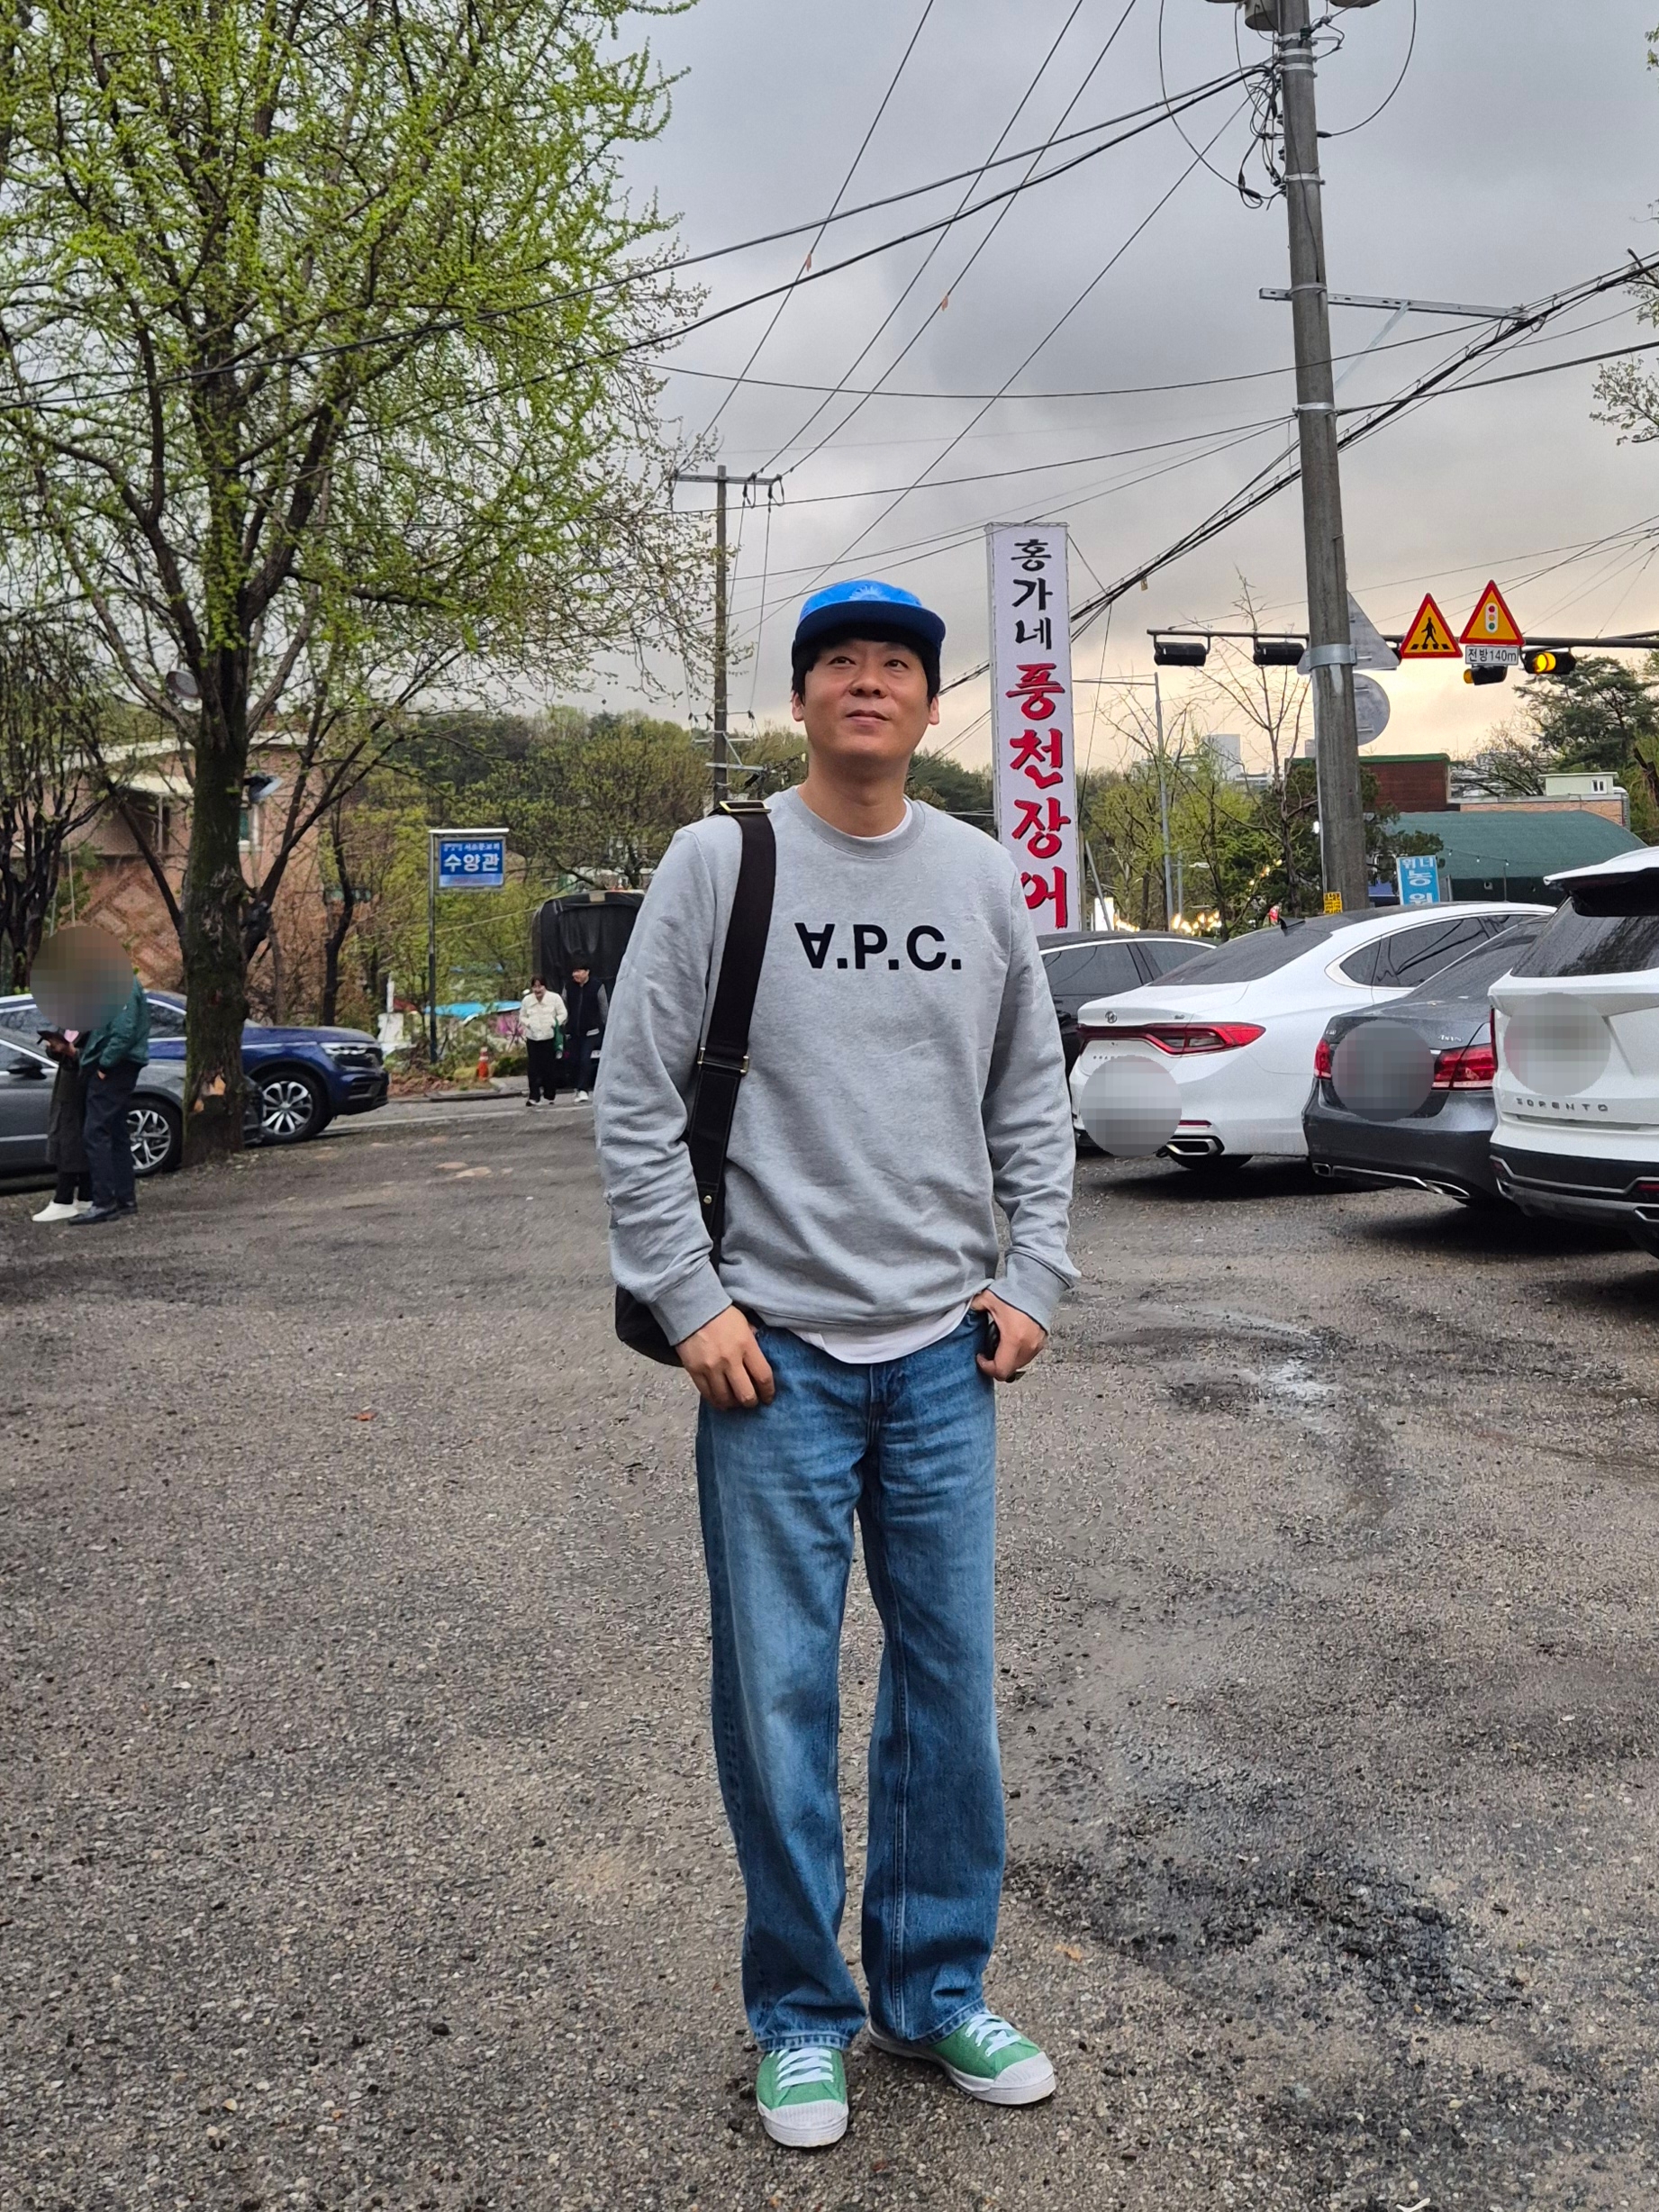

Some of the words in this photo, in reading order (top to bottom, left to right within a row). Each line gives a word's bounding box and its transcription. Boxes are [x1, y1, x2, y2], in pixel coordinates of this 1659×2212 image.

[1010, 538, 1053, 650] 홍가네
[1005, 662, 1071, 929] 풍천장어
[444, 853, 501, 873] 수양관
[1401, 857, 1434, 869] 위너
[793, 921, 962, 971] A.P.C.
[1516, 1097, 1609, 1112] SORENTO
